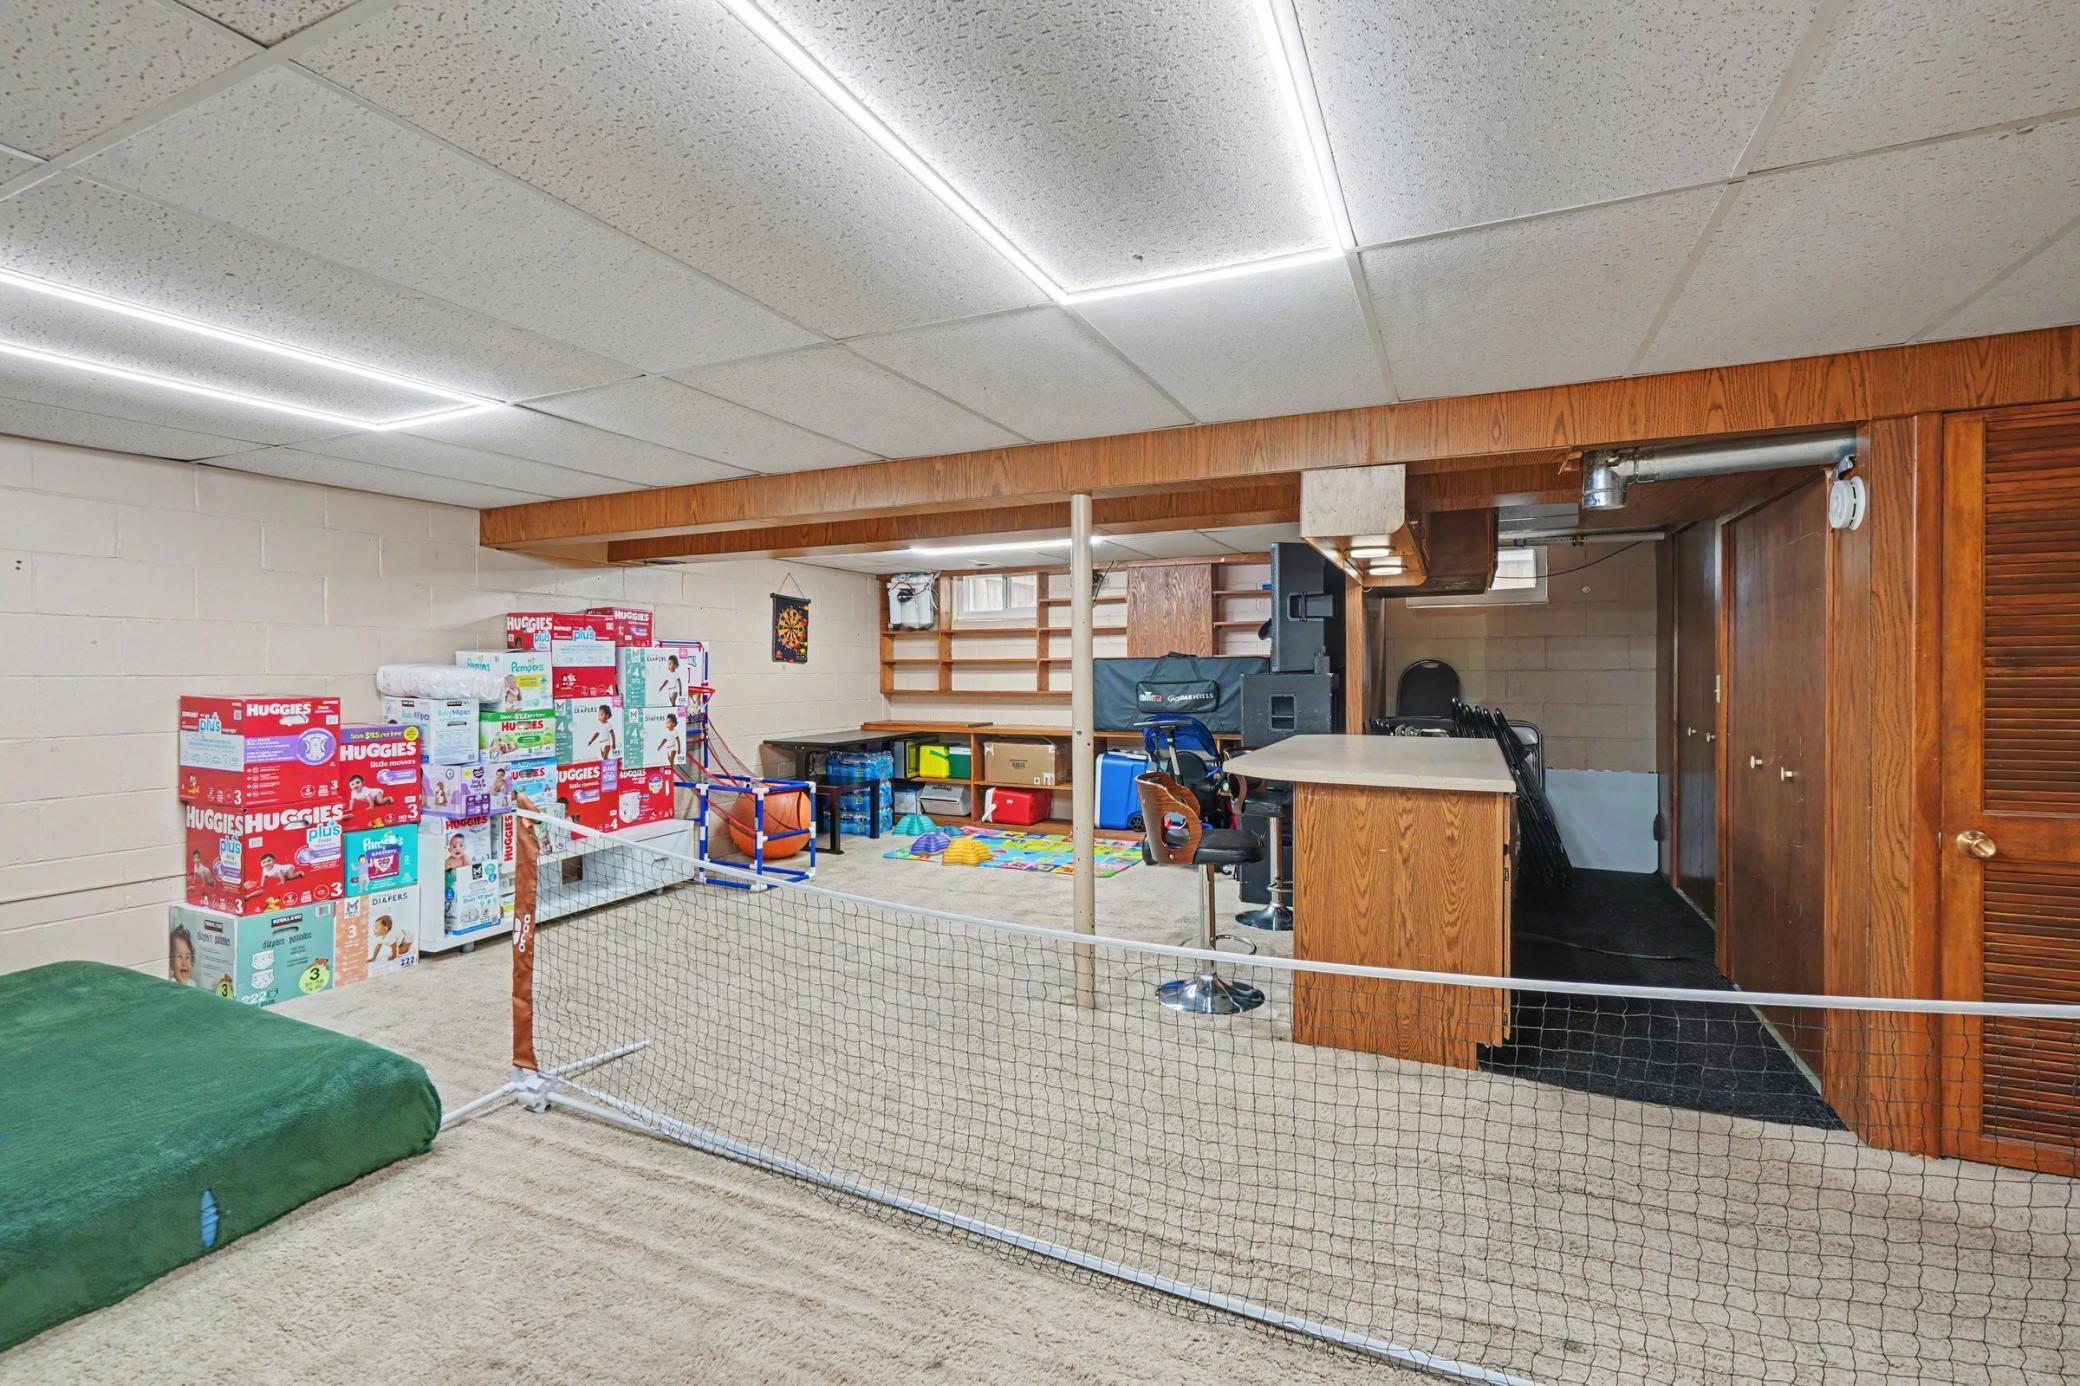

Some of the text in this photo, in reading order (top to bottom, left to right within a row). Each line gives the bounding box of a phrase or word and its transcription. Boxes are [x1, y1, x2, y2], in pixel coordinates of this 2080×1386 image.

[506, 616, 553, 632] HUGGIES
[573, 628, 595, 641] plus
[511, 661, 544, 673] Pampers
[246, 703, 311, 717] HUGGIES
[558, 721, 565, 732] 4
[340, 742, 417, 762] HUGGIES
[558, 766, 600, 783] UGGIES
[331, 780, 338, 790] 3
[233, 789, 242, 805] 3
[244, 803, 344, 834] HUGGIES
[407, 804, 418, 819] 3
[186, 805, 243, 836] HUGGIES
[610, 818, 618, 829] 4
[308, 823, 341, 842] plus
[504, 815, 513, 862] HUGGIES
[220, 836, 241, 855] plus
[330, 882, 342, 897] 3
[372, 892, 408, 905] DIAPERS
[234, 899, 243, 914] 3
[347, 925, 357, 938] 3
[309, 968, 320, 980] 3
[221, 983, 228, 997] 3
